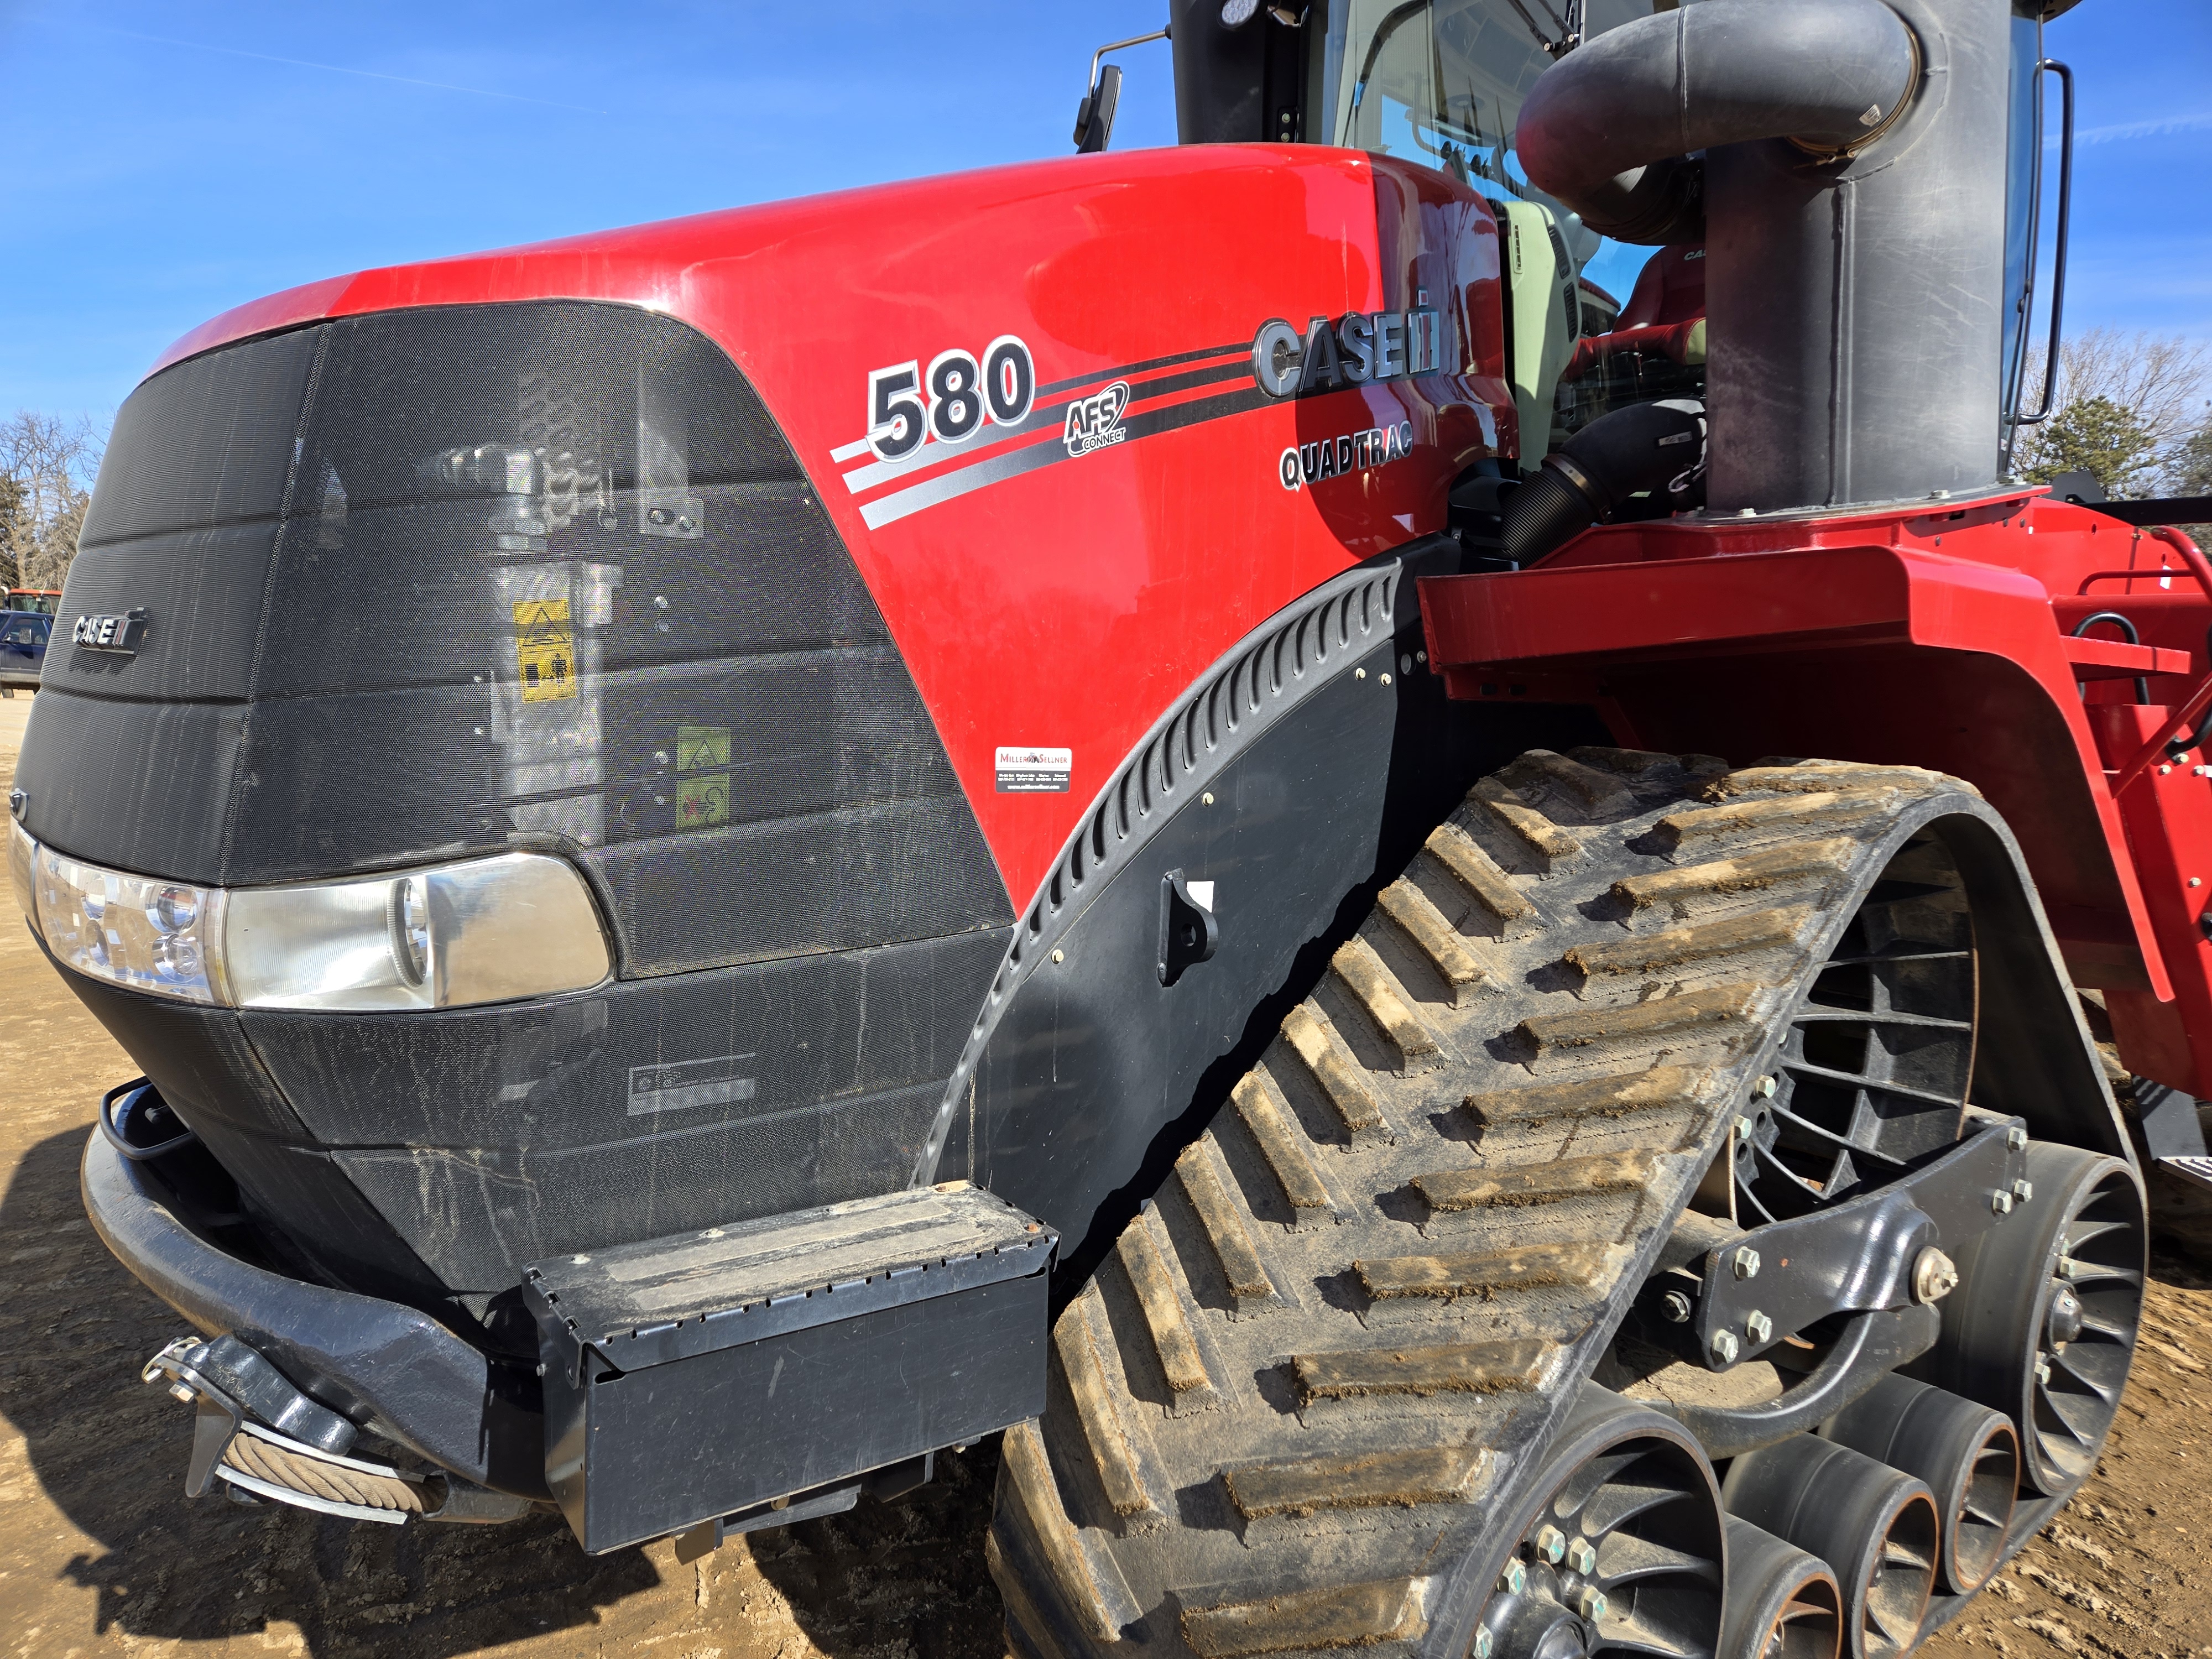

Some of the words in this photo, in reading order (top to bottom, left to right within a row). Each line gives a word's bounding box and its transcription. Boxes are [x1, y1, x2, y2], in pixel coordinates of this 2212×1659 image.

[1684, 249, 1706, 260] CA
[1253, 312, 1403, 398] CASE
[866, 334, 1035, 463] 580
[1063, 389, 1119, 444] AFS
[1082, 427, 1126, 451] CONNECT
[1279, 419, 1413, 492] QUADTRAC
[72, 615, 113, 644] CASE
[1000, 753, 1027, 763] MILLER
[1039, 754, 1067, 763] SELLNER
